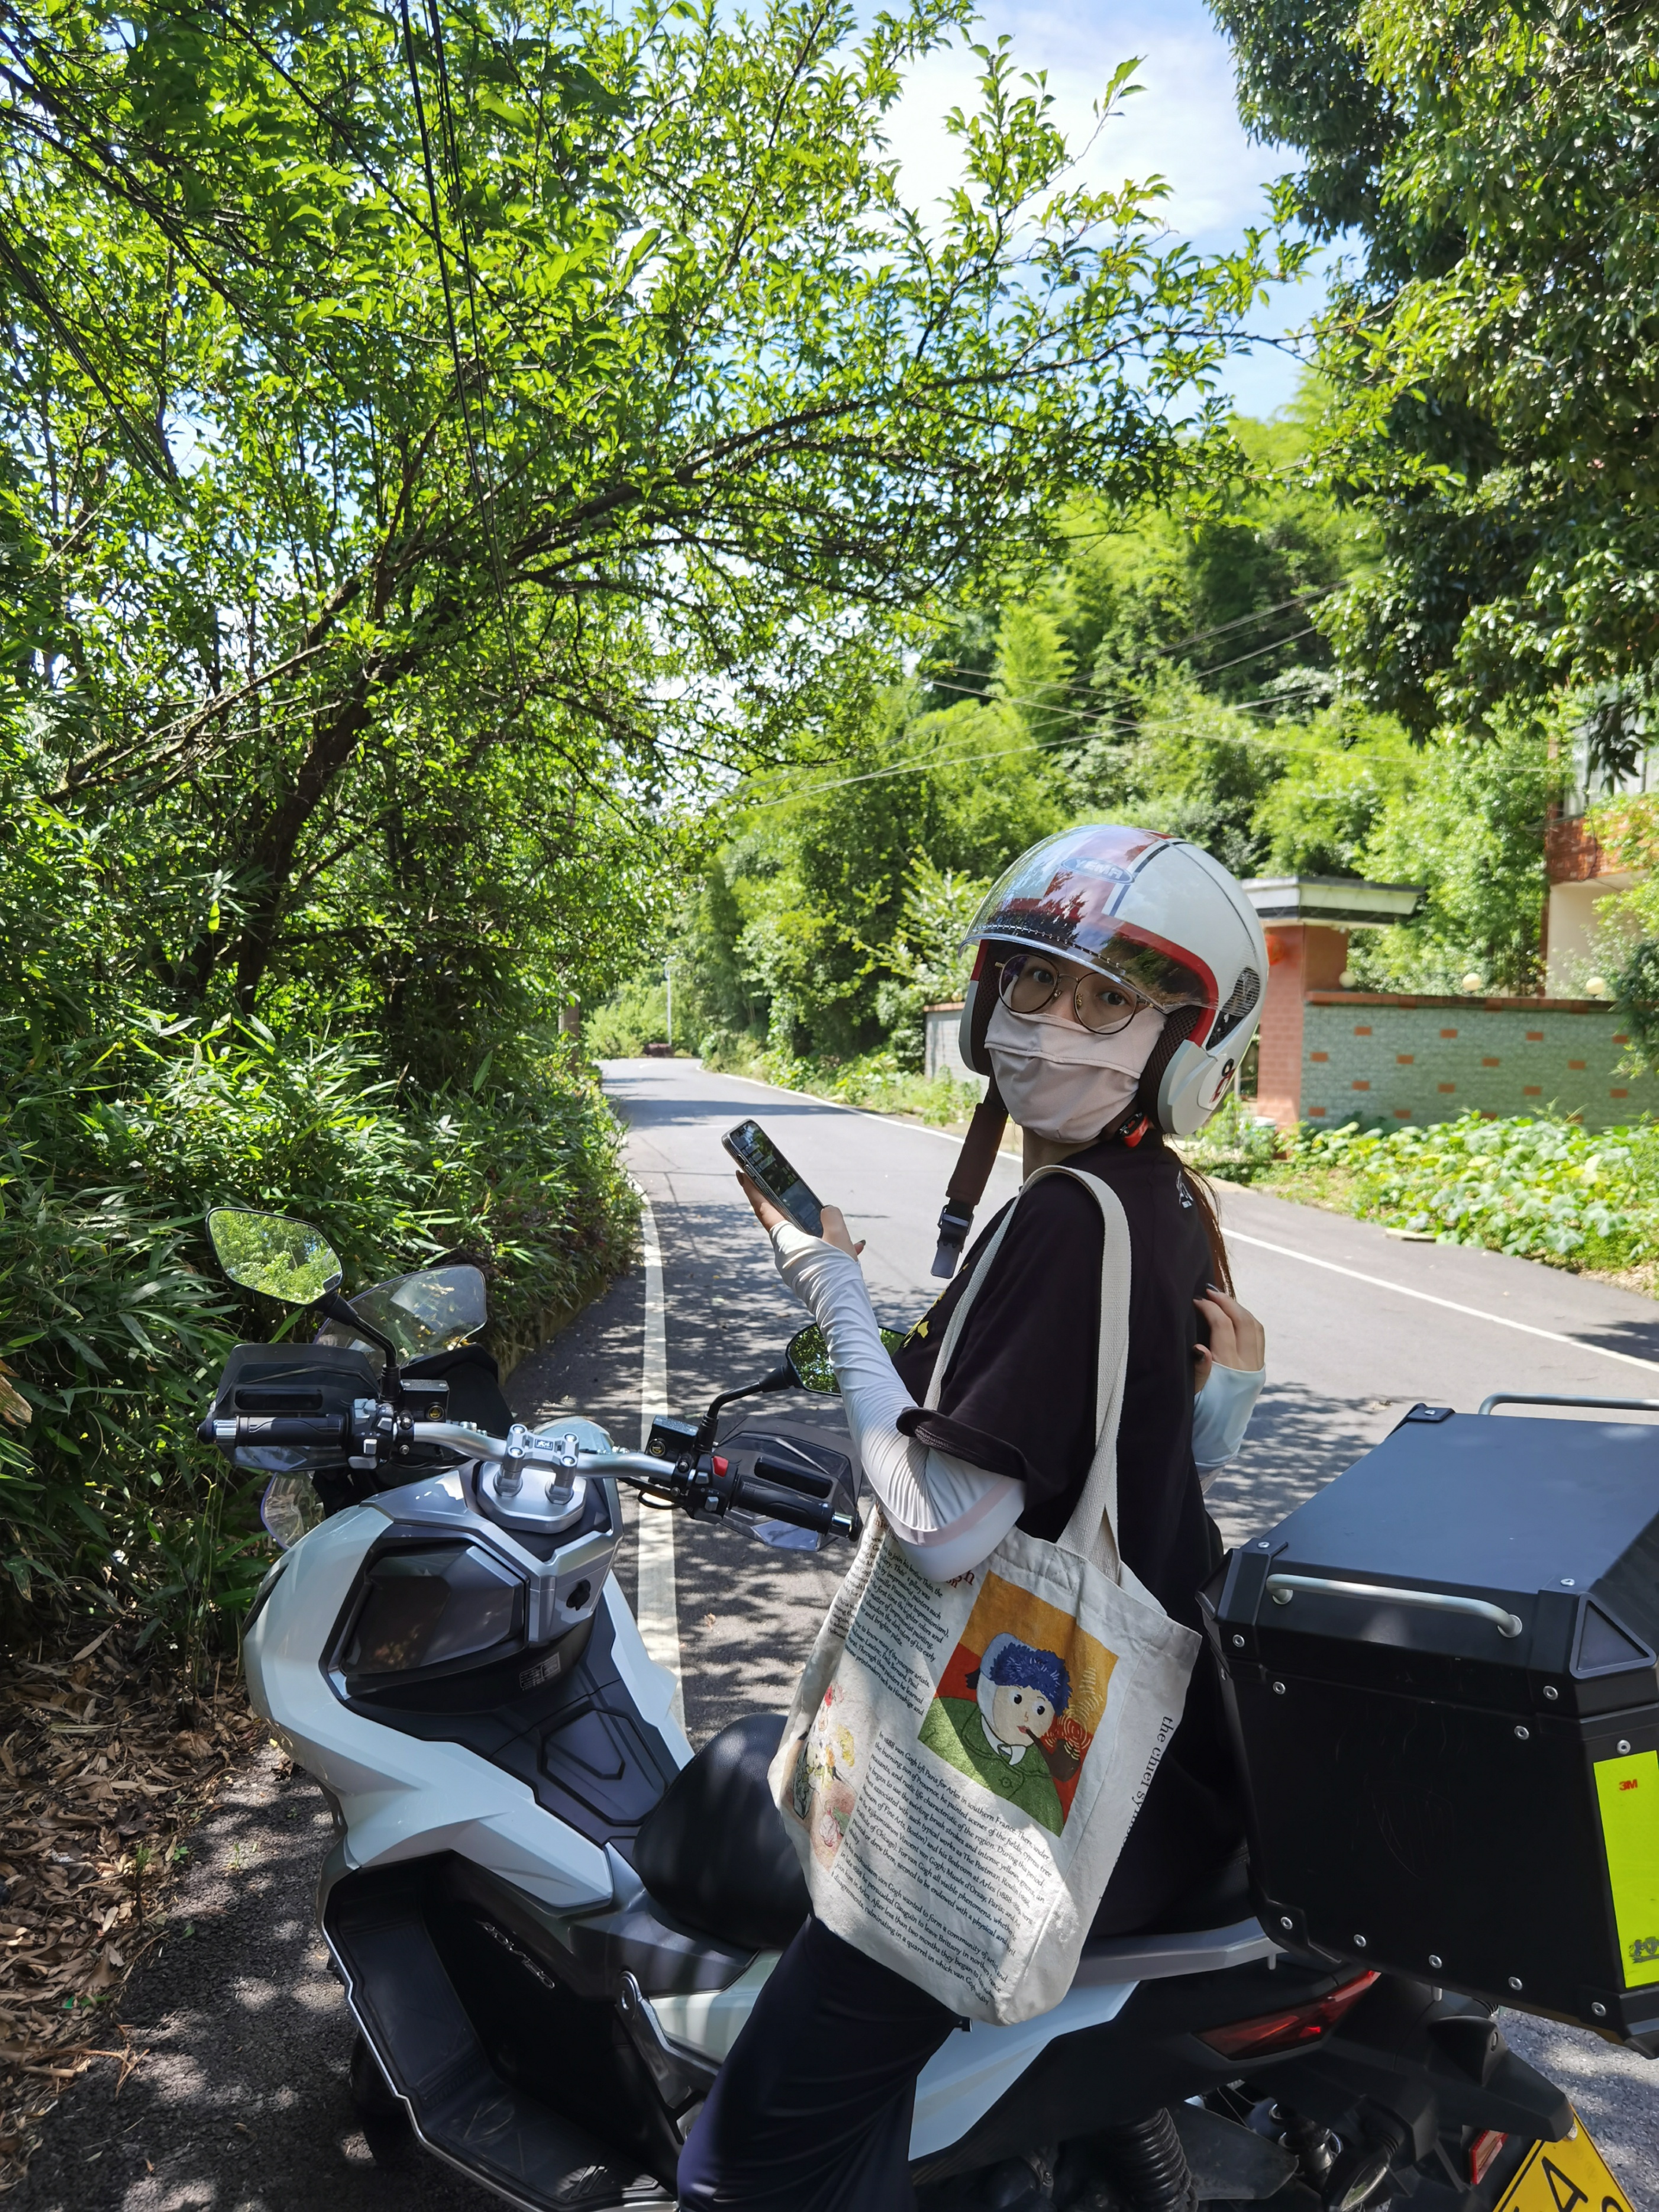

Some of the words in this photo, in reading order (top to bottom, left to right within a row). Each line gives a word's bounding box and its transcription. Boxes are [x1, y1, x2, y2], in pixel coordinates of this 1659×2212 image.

[1075, 858, 1124, 880] YEMA
[870, 1592, 885, 1605] matter
[889, 1553, 903, 1563] join
[934, 1588, 943, 1598] the
[921, 1591, 931, 1601] was
[864, 1611, 875, 1620] and
[874, 1616, 892, 1633] brighter
[875, 1585, 887, 1597] first
[887, 1594, 898, 1605] time
[918, 1623, 931, 1636] colors
[931, 1633, 944, 1643] and
[929, 1609, 941, 1620] such
[858, 1645, 877, 1662] Through
[906, 1687, 924, 1704] learned
[866, 1629, 879, 1642] know
[896, 1659, 915, 1675] younger
[914, 1673, 929, 1688] artists,
[908, 1678, 919, 1689] Paul
[922, 1650, 935, 1662] early
[893, 1688, 914, 1708] Hiroshige
[914, 1706, 925, 1716] and
[1156, 1716, 1174, 1742] the
[1140, 1746, 1161, 1787] chief
[1619, 1779, 1638, 1791] 3M
[871, 1754, 890, 1774] peasants,
[891, 1772, 903, 1782] and
[915, 1789, 924, 1800] life
[924, 1797, 957, 1826] characteristic
[964, 1827, 974, 1837] the
[974, 1835, 995, 1849] region.
[997, 1845, 1018, 1866] During
[1018, 1861, 1027, 1872] this
[872, 1767, 886, 1784] began
[892, 1787, 901, 1795] use
[901, 1792, 909, 1803] the
[909, 1801, 929, 1820] swirling
[929, 1814, 945, 1830] brush
[945, 1828, 964, 1845] strokes
[964, 1843, 978, 1853] and
[977, 1849, 1000, 1866] intense
[882, 1747, 902, 1769] burning
[902, 1766, 912, 1776] sun
[916, 1777, 939, 1799] Provence,
[947, 1802, 969, 1819] painted
[968, 1817, 987, 1831] scenes
[996, 1831, 1006, 1842] the
[1004, 1837, 1022, 1855] fields,
[895, 1746, 904, 1756] van
[905, 1753, 917, 1766] Gogh
[917, 1762, 926, 1774] left
[925, 1769, 938, 1784] Paris
[936, 1779, 947, 1788] for
[946, 1787, 961, 1800] Arles
[967, 1803, 994, 1821] southern
[1033, 1847, 1050, 1860] under
[868, 1807, 898, 1837] Rijksmuseum
[899, 1833, 919, 1852] Vincent
[919, 1850, 928, 1860] van
[929, 1856, 946, 1873] Gogh;
[1005, 1911, 1015, 1922] and
[874, 1786, 899, 1807] associated
[899, 1805, 909, 1817] with
[908, 1815, 921, 1826] such
[922, 1823, 940, 1840] typical
[940, 1837, 956, 1852] works
[964, 1852, 974, 1865] The
[975, 1860, 1000, 1881] Postman
[1001, 1877, 1018, 1895] Roulin
[884, 1805, 895, 1818] Fine
[894, 1816, 906, 1830] Arts,
[906, 1826, 928, 1845] Boston)
[927, 1842, 939, 1853] and
[938, 1847, 947, 1859] his
[948, 1855, 972, 1877] Bedroom
[979, 1879, 995, 1892] Arles
[870, 1839, 883, 1852] drew
[883, 1849, 896, 1866] them,
[897, 1862, 918, 1879] seemed
[931, 1888, 956, 1907] endowed
[956, 1905, 968, 1916] with
[972, 1918, 997, 1937] physical
[996, 1934, 1008, 1945] and
[898, 1847, 908, 1858] For
[908, 1856, 917, 1866] van
[918, 1862, 932, 1877] Gogh
[932, 1874, 941, 1882] all
[941, 1881, 958, 1895] visible
[957, 1893, 992, 1920] phenomena,
[834, 1863, 845, 1874] join
[844, 1869, 853, 1883] him
[871, 1898, 885, 1910] After
[885, 1907, 895, 1920] less
[895, 1916, 908, 1929] than
[908, 1926, 918, 1937] two
[919, 1936, 940, 1953] months
[941, 1950, 954, 1963] they
[954, 1957, 973, 1973] began
[834, 1875, 870, 1909] disagreements,
[864, 1907, 895, 1936] culminating
[906, 1940, 928, 1957] quarrel
[935, 1960, 953, 1974] which
[954, 1971, 964, 1981] van
[854, 1853, 877, 1878] enthusiasm
[878, 1876, 887, 1887] van
[887, 1883, 902, 1898] Gogh
[903, 1896, 923, 1913] wanted
[927, 1914, 942, 1929] form
[947, 1930, 980, 1955] community
[996, 1971, 1008, 1983] and
[867, 1882, 895, 1905] persuaded
[894, 1902, 917, 1923] Gauguin
[924, 1923, 938, 1938] leave
[938, 1934, 961, 1955] Brittany
